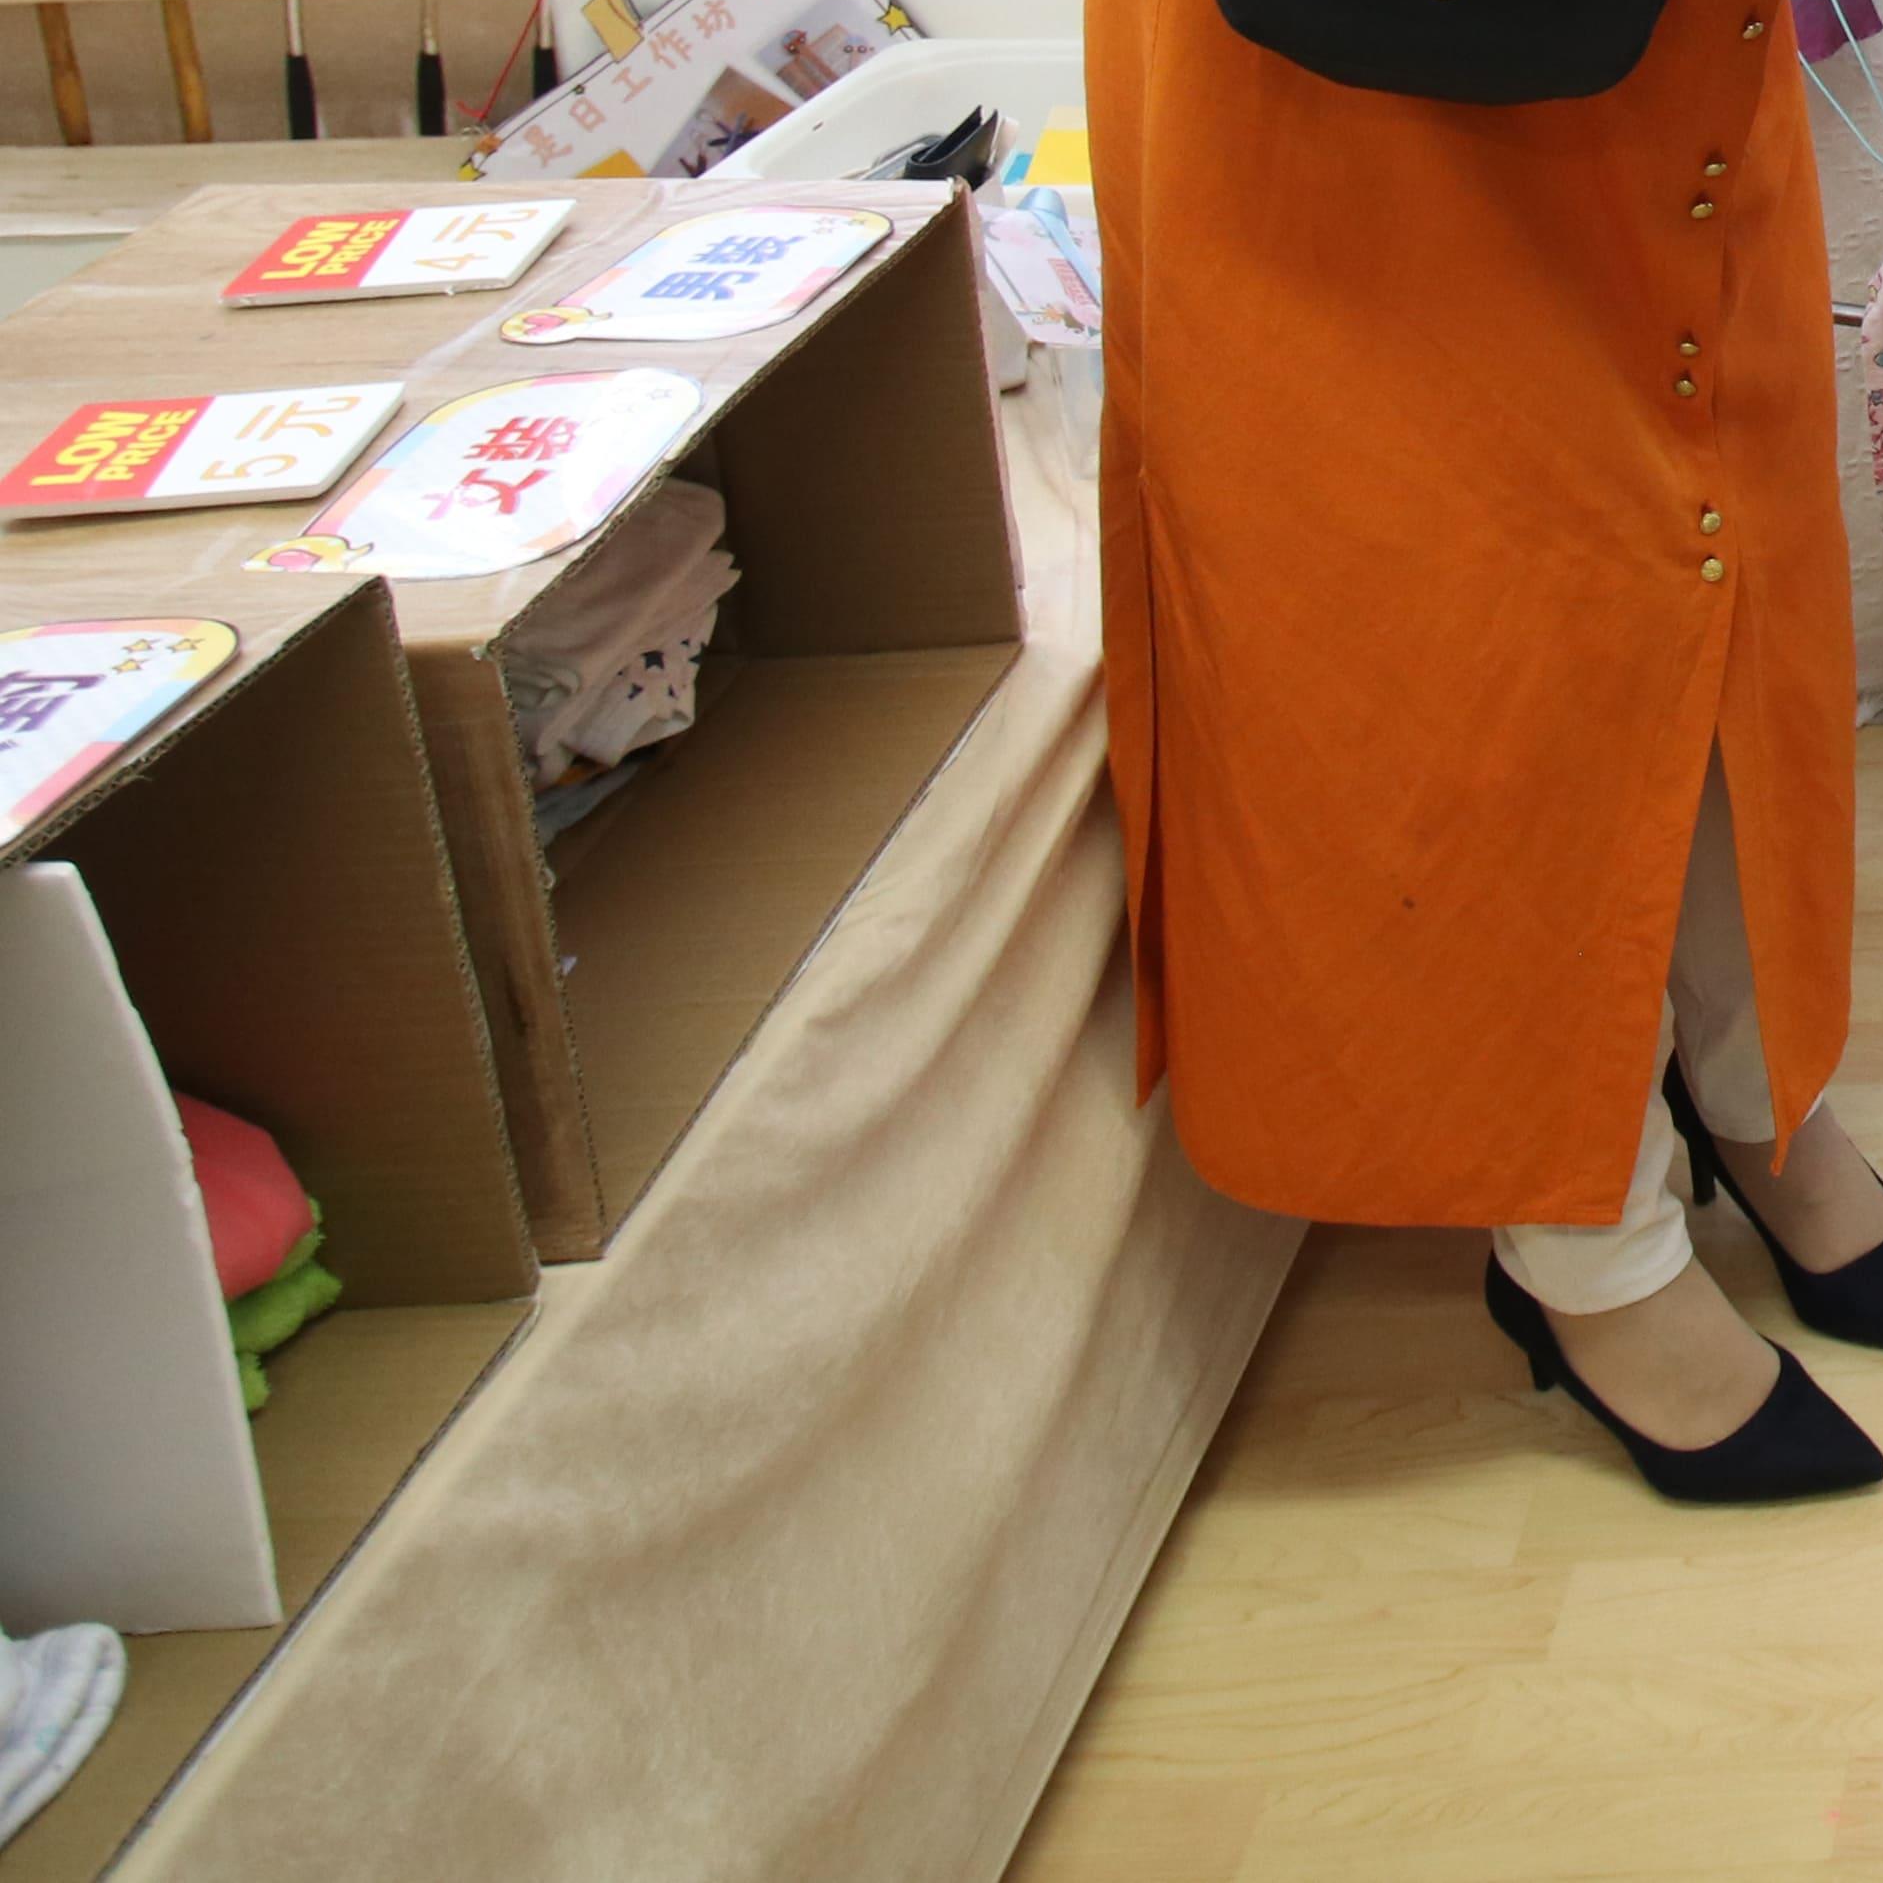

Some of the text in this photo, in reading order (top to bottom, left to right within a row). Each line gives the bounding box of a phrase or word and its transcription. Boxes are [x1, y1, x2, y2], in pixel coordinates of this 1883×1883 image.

[261, 221, 358, 280] LOW
[315, 218, 400, 276] PRICE
[640, 234, 806, 301] 男裝
[28, 410, 150, 486] LOW
[94, 407, 198, 482] PRICE
[421, 415, 591, 520] 女裝
